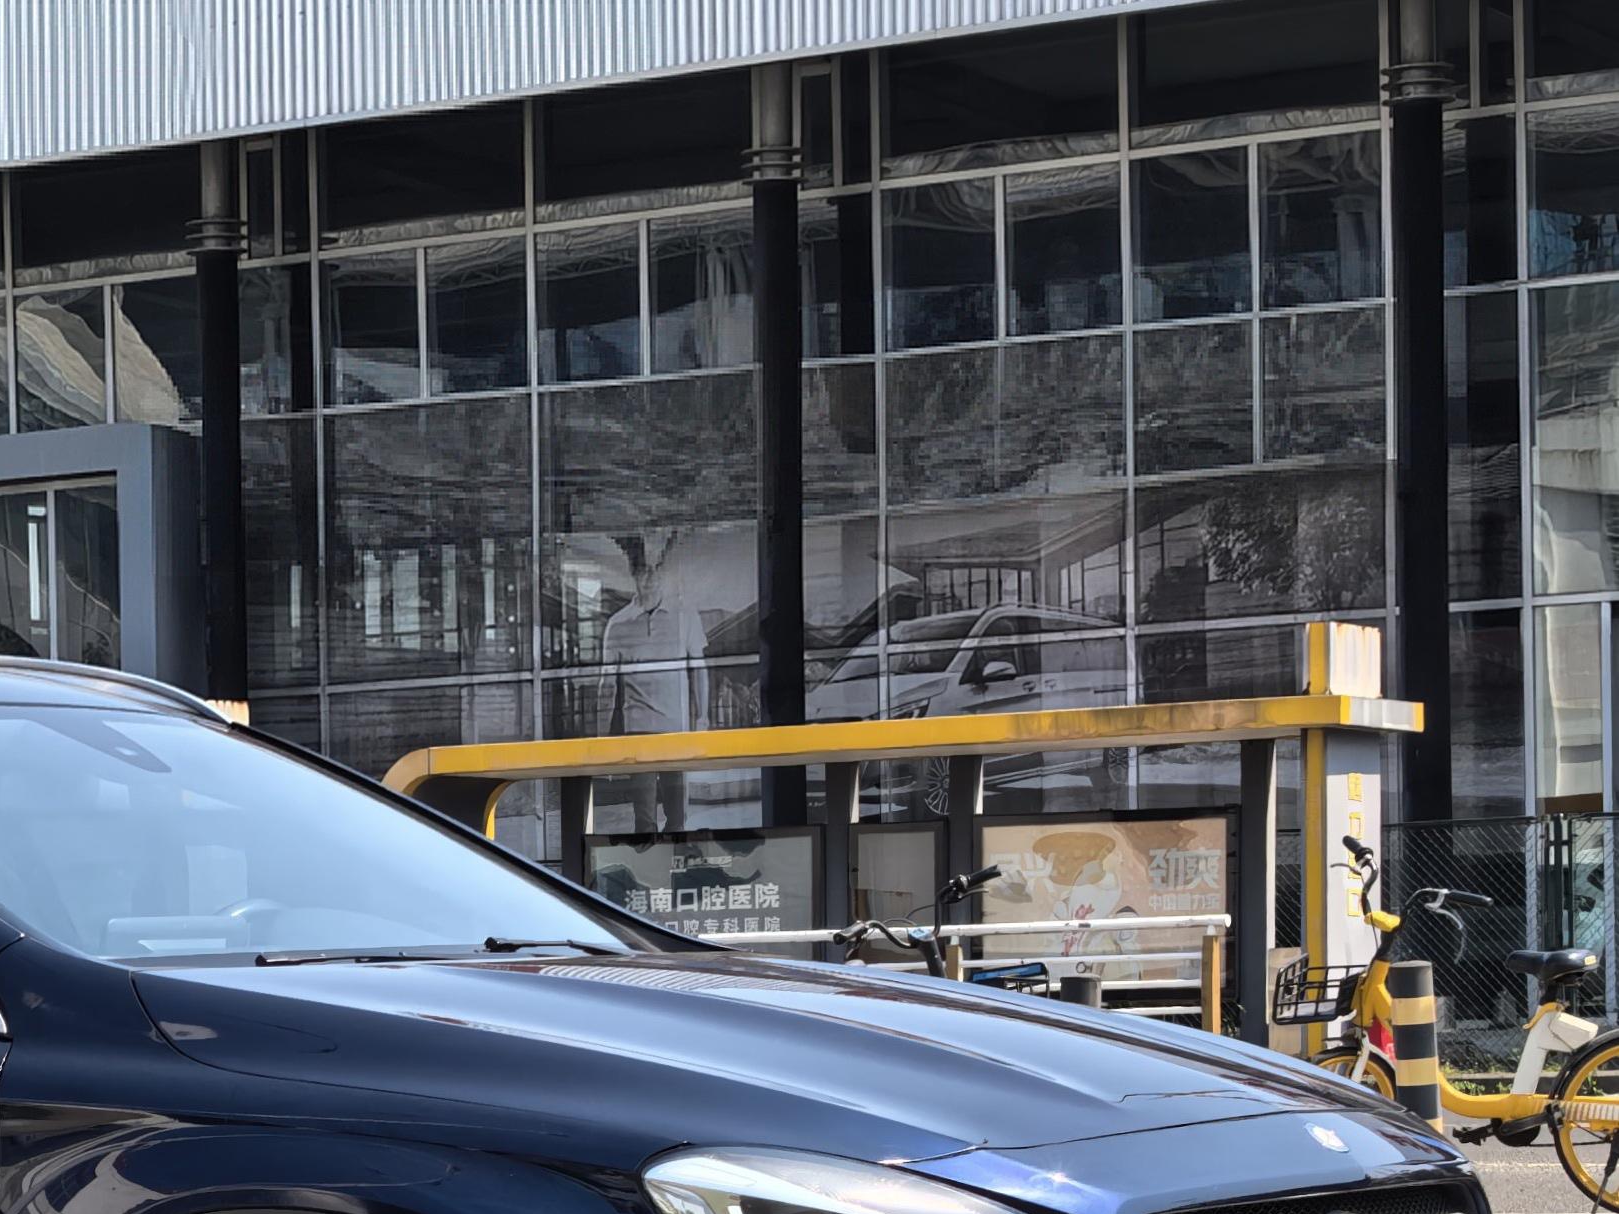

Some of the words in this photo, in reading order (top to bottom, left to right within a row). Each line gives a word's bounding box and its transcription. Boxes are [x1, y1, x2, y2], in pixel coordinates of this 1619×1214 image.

[1148, 847, 1221, 891] 劲爽
[624, 882, 780, 914] 海南口腔医院
